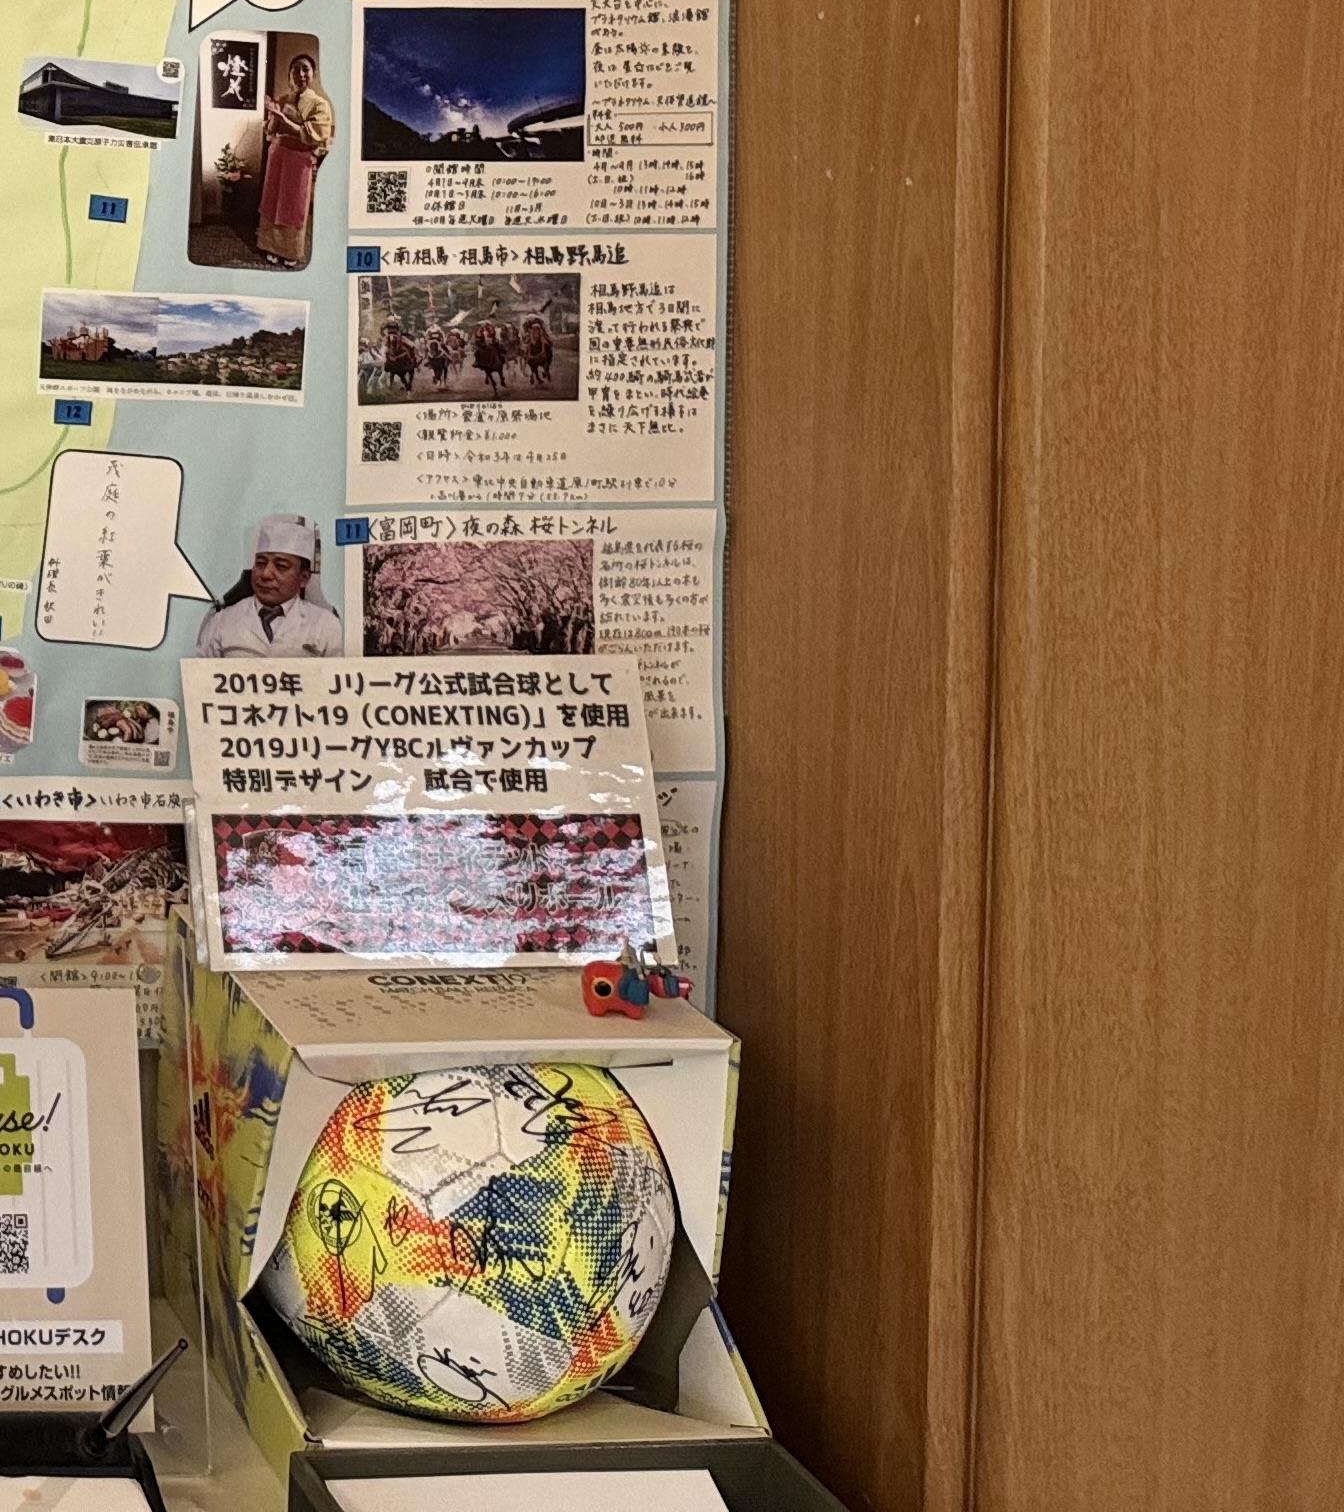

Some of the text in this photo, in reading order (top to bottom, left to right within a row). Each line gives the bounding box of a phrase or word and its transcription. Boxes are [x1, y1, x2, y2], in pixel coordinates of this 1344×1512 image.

[529, 515, 618, 536] 桜トンネル
[213, 671, 613, 697] 2019年 Jリーグ公式試合球として
[219, 734, 597, 761] 2019JリーグYBCルヴァンカップ
[222, 767, 548, 793] 特別デザイン 試合で使用
